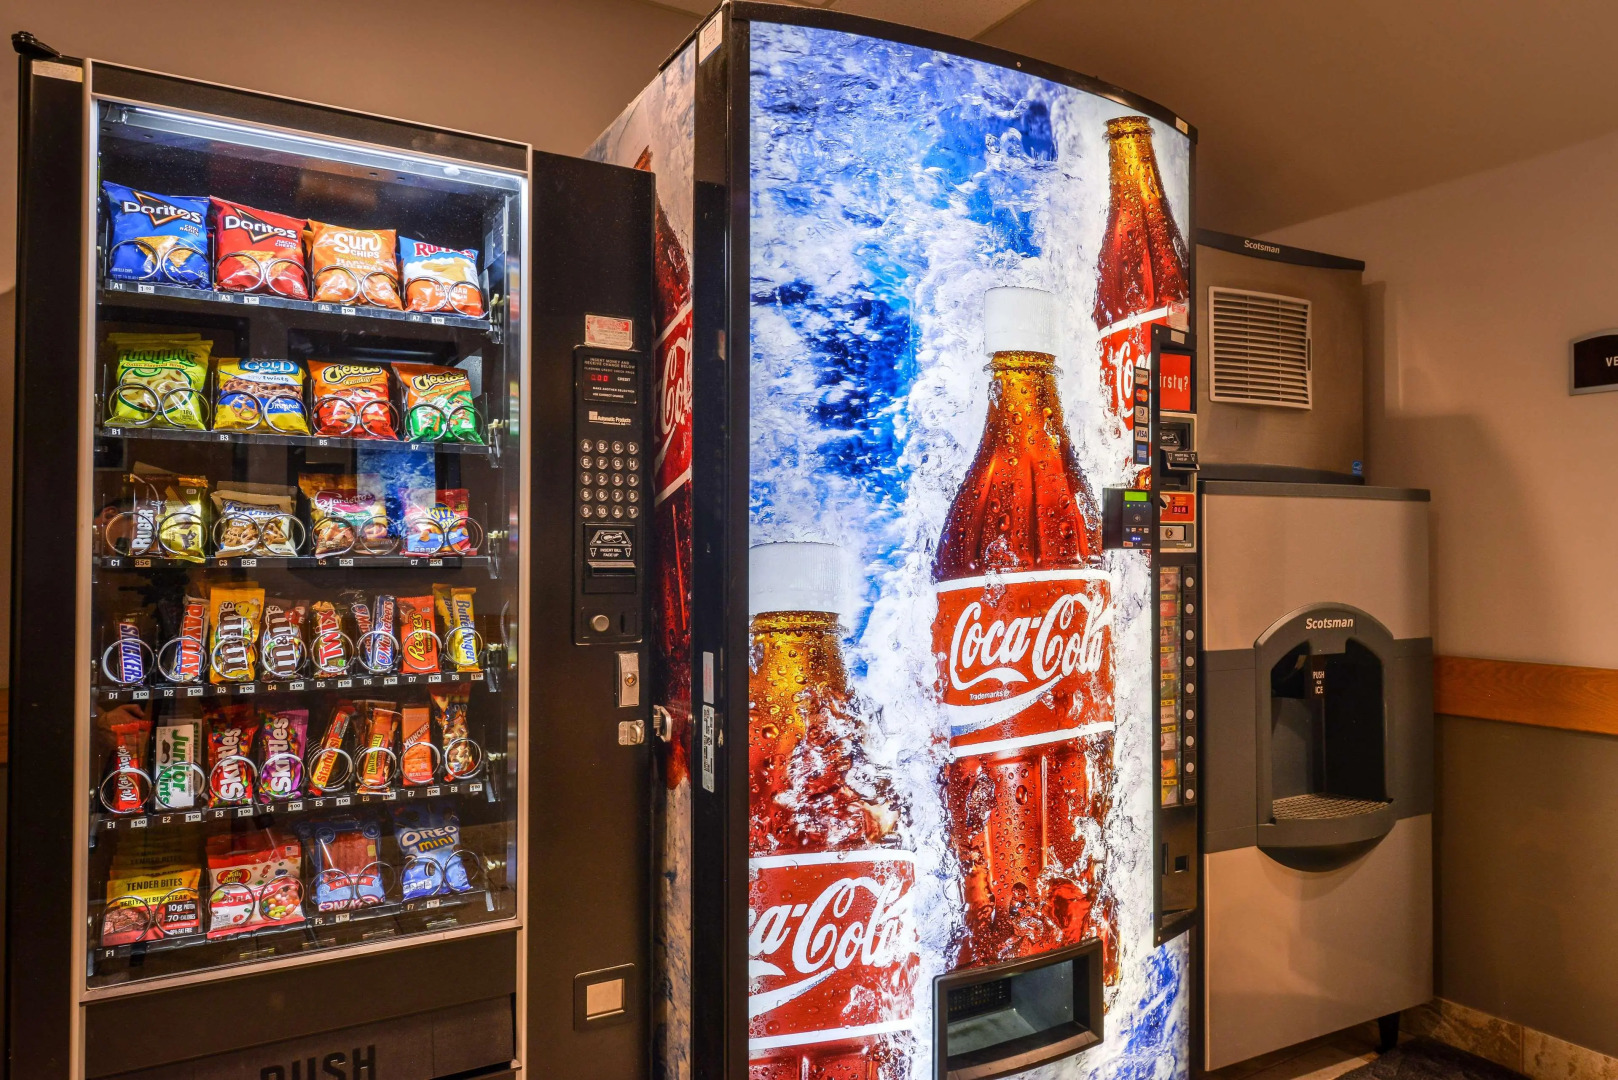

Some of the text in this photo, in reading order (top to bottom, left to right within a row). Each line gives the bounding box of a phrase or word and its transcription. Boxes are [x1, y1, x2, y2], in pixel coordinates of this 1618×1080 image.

[123, 201, 202, 224] Doritos
[225, 216, 297, 238] Doritos
[333, 232, 382, 254] Sun
[1244, 239, 1280, 254] Scotsman
[350, 249, 380, 259] CHIPS
[221, 294, 230, 302] A3
[244, 360, 295, 372] GOLD
[414, 372, 465, 390] Cheetos
[1136, 430, 1147, 438] VISA
[425, 507, 453, 520] RITZ
[378, 600, 394, 663] 3 Muketeers
[1306, 618, 1354, 630] Scotsman
[181, 604, 204, 676] PAYDAY
[408, 612, 425, 662] Reese's
[950, 593, 1109, 691] Coca-Cola
[120, 622, 144, 685] SNICKERS
[1313, 671, 1325, 679] PUSH
[1315, 686, 1323, 694] ICE
[172, 730, 189, 792] Junior
[268, 718, 292, 792] Skitles
[160, 765, 171, 804] Mints
[402, 825, 458, 846] OREO
[418, 836, 454, 852] mini
[222, 876, 239, 884] Belly
[228, 868, 242, 878] Jelly
[126, 878, 182, 891] TENDER BITES
[167, 894, 188, 902] STEAK
[168, 904, 182, 912] 10g
[168, 914, 178, 922] 70
